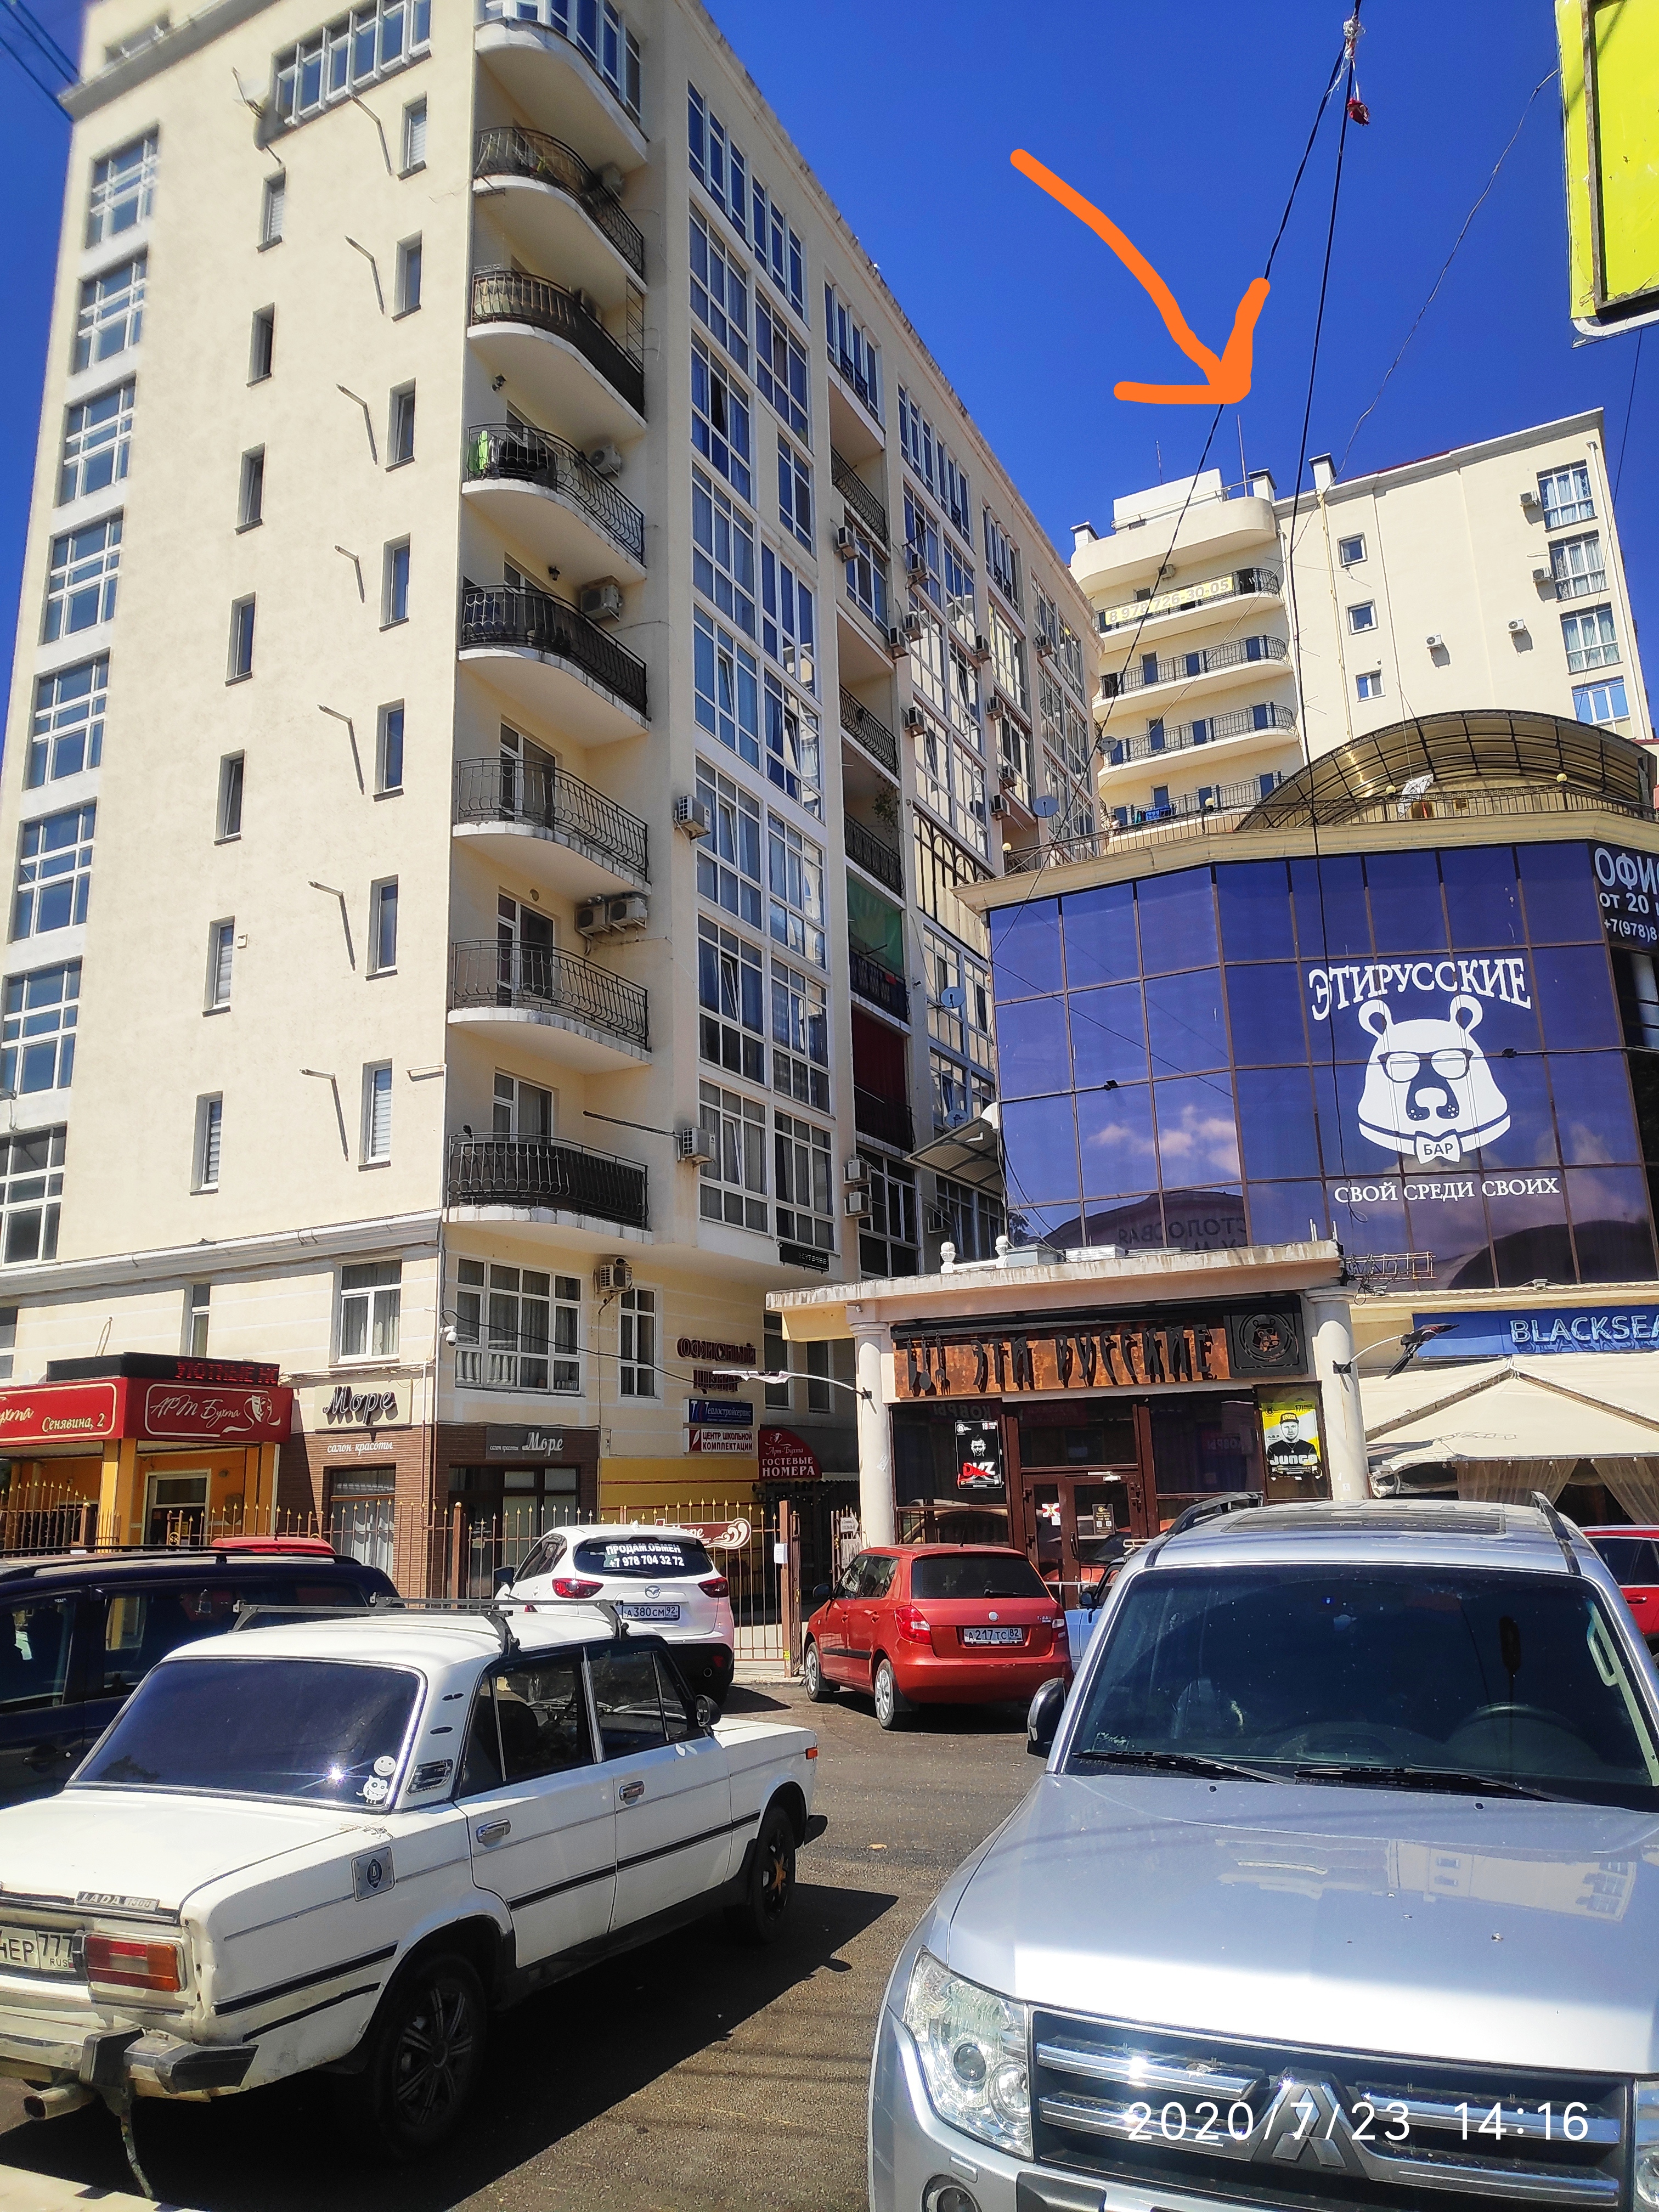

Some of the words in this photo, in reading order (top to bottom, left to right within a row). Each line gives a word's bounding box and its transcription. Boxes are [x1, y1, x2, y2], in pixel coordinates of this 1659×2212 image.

[1109, 611, 1118, 623] 8
[1121, 602, 1148, 619] 978
[1595, 848, 1659, 895] ОФИ
[1599, 893, 1620, 909] от
[1626, 893, 1649, 914] 20
[1309, 958, 1531, 1020] ЭТИРУССКИЕ
[1424, 1143, 1454, 1156] БАР
[1334, 1182, 1398, 1203] СВОЙ
[1404, 1182, 1475, 1202] СРЕДИ
[1482, 1177, 1560, 1197] СВОИХ
[677, 1338, 756, 1364] ОФИСНЫЙ
[970, 1336, 1030, 1385] ЭТИ
[1056, 1324, 1211, 1380] РУССКИЕ
[201, 1399, 241, 1428] Бухта
[321, 1387, 397, 1425] Море
[42, 1414, 94, 1433] Сенявина,
[97, 1413, 106, 1427] 2
[522, 1431, 564, 1457] Море
[703, 1431, 721, 1441] ЦЕНТР
[723, 1431, 753, 1441] ШКОЛЬНОЙ
[327, 1444, 352, 1453] салон
[355, 1441, 393, 1456] красоты
[703, 1442, 753, 1452] КОМПЛЕКТАЦИИ
[762, 1457, 814, 1466] ГОСТЕВЫЕ
[762, 1466, 815, 1477] НОМЕРА
[609, 1557, 620, 1567] +7
[622, 1556, 640, 1566] 978
[641, 1555, 658, 1565] 704
[659, 1555, 672, 1565] 32
[673, 1556, 685, 1566] 72
[1009, 1629, 1019, 1637] 82
[80, 1893, 121, 1905] LADA
[38, 1933, 73, 1957] 777
[49, 1958, 68, 1968] RUS
